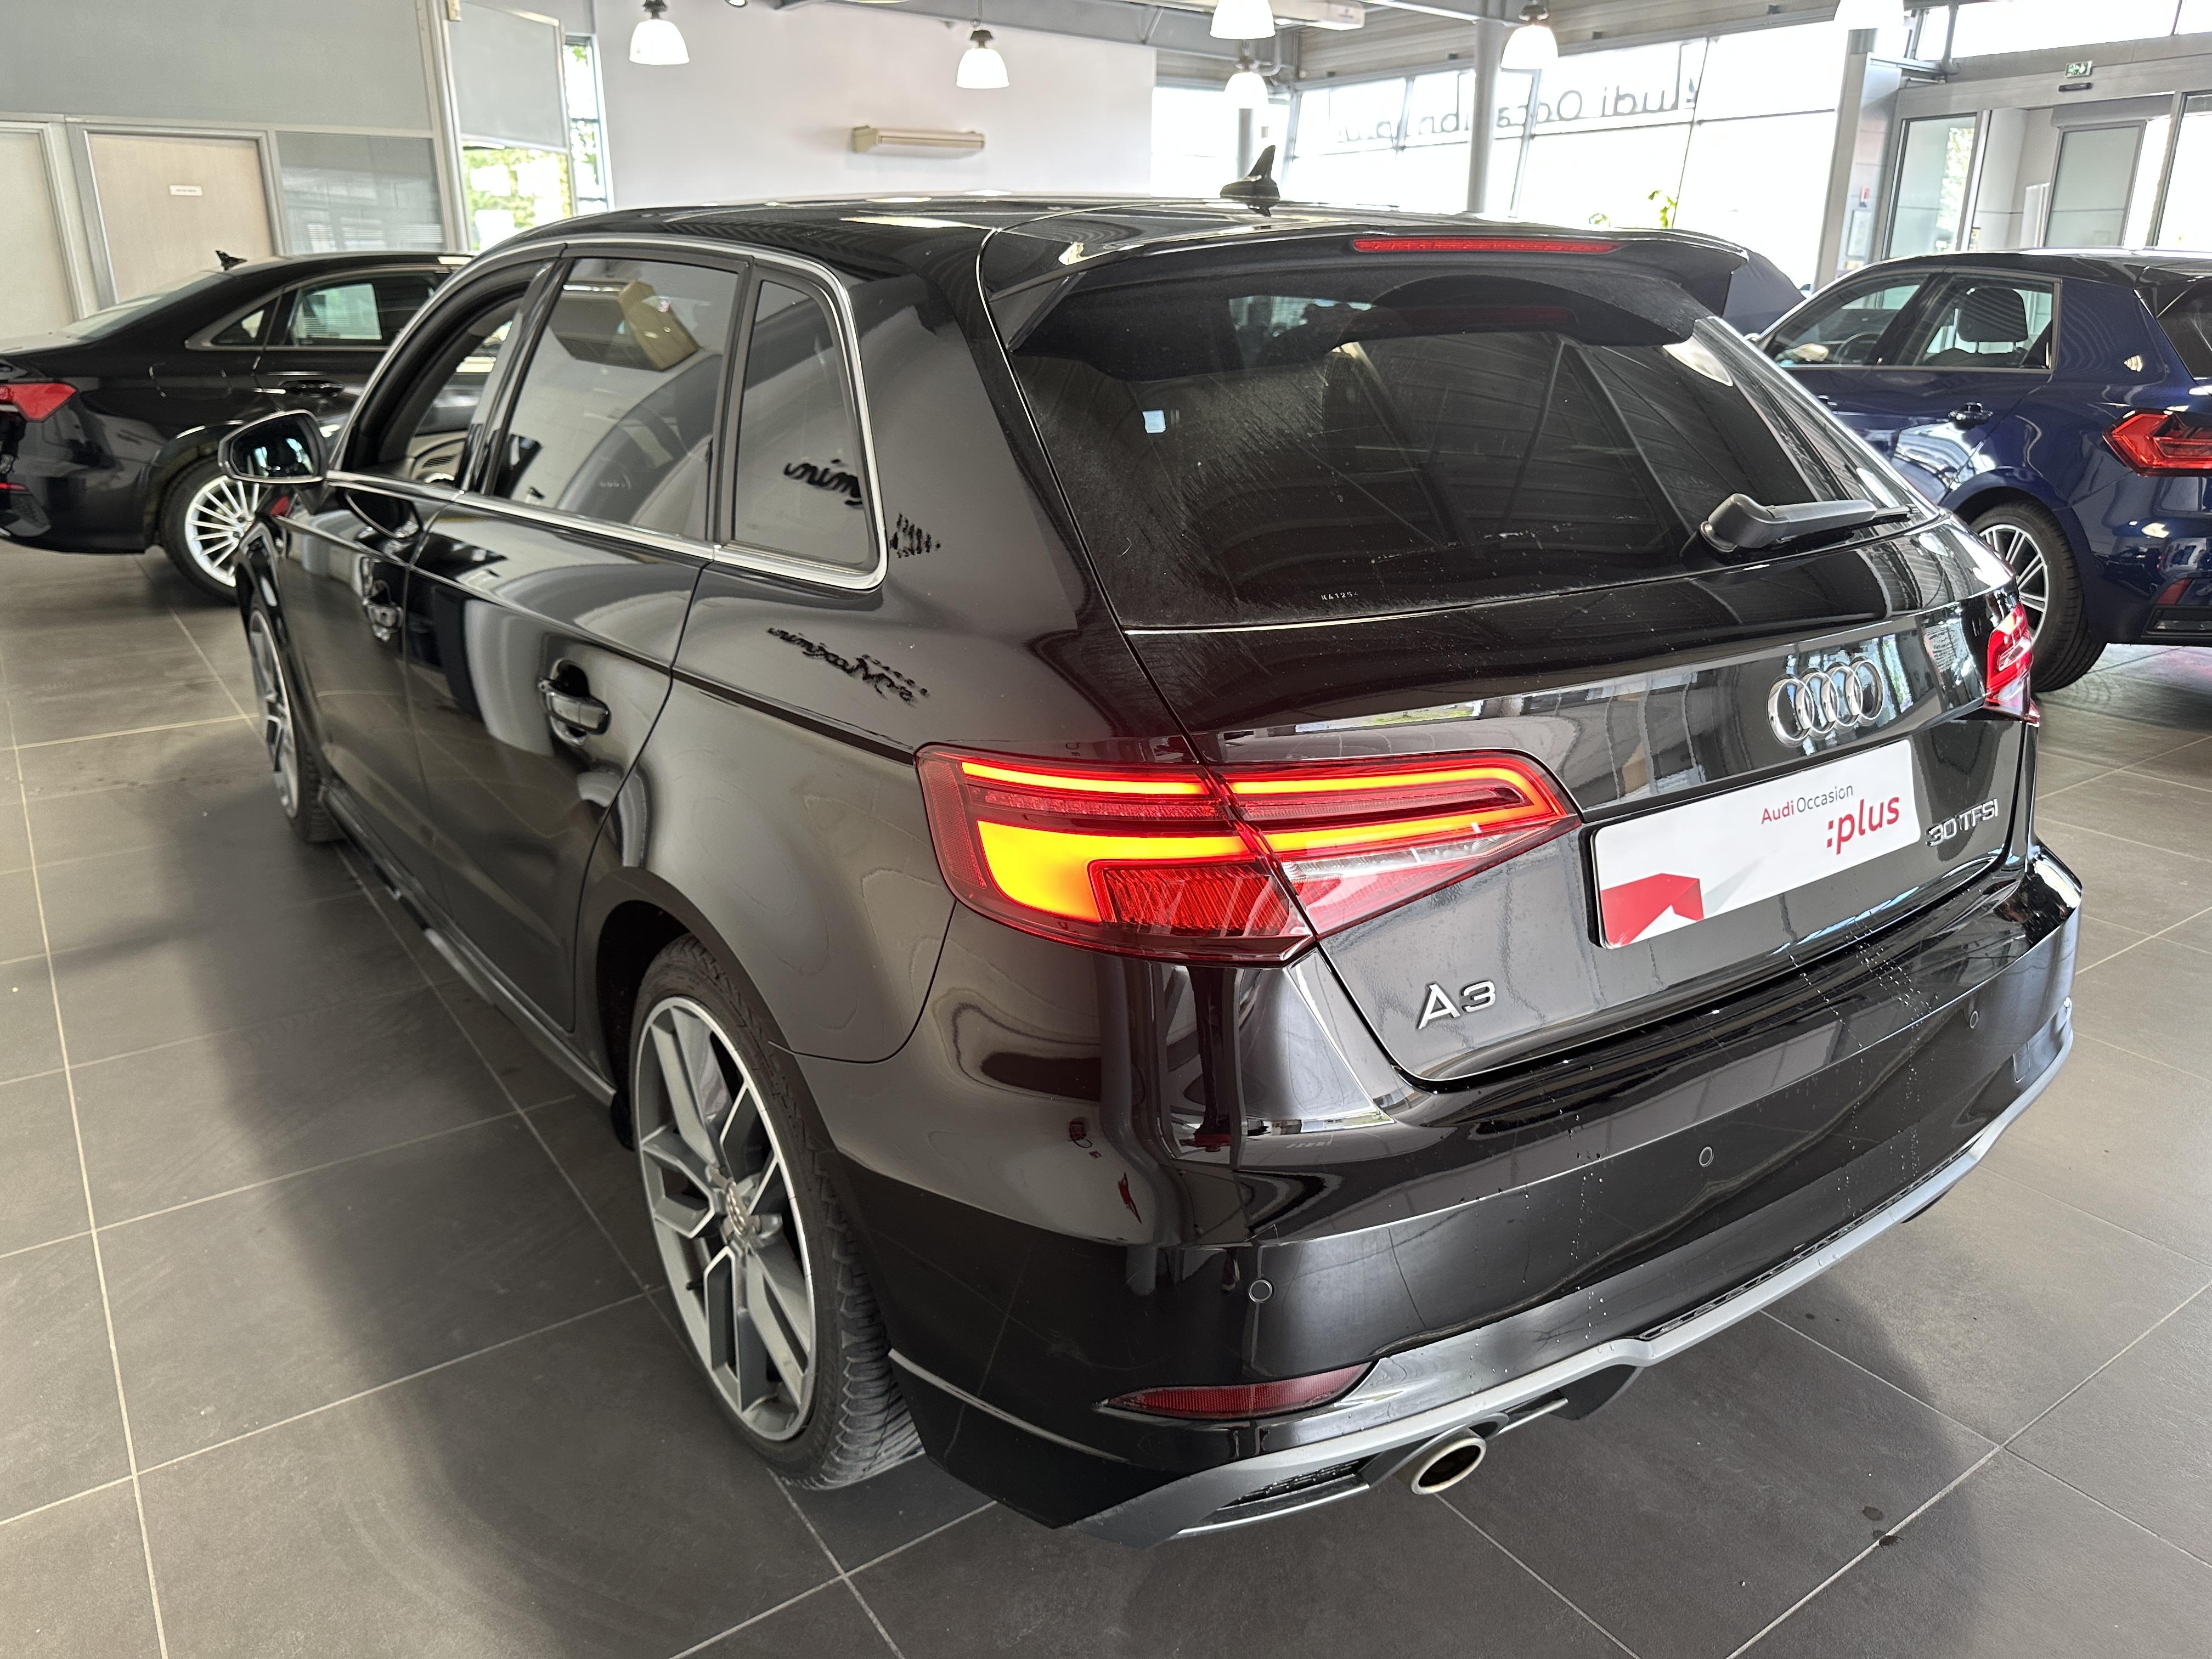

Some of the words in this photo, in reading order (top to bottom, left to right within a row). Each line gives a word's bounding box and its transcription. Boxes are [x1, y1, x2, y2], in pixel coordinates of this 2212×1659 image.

[1761, 799, 1795, 825] Audi
[1796, 785, 1854, 813] Occasion
[1925, 817, 1957, 847] 30
[1958, 798, 1999, 831] TFSI
[1417, 980, 1496, 1030] A3
